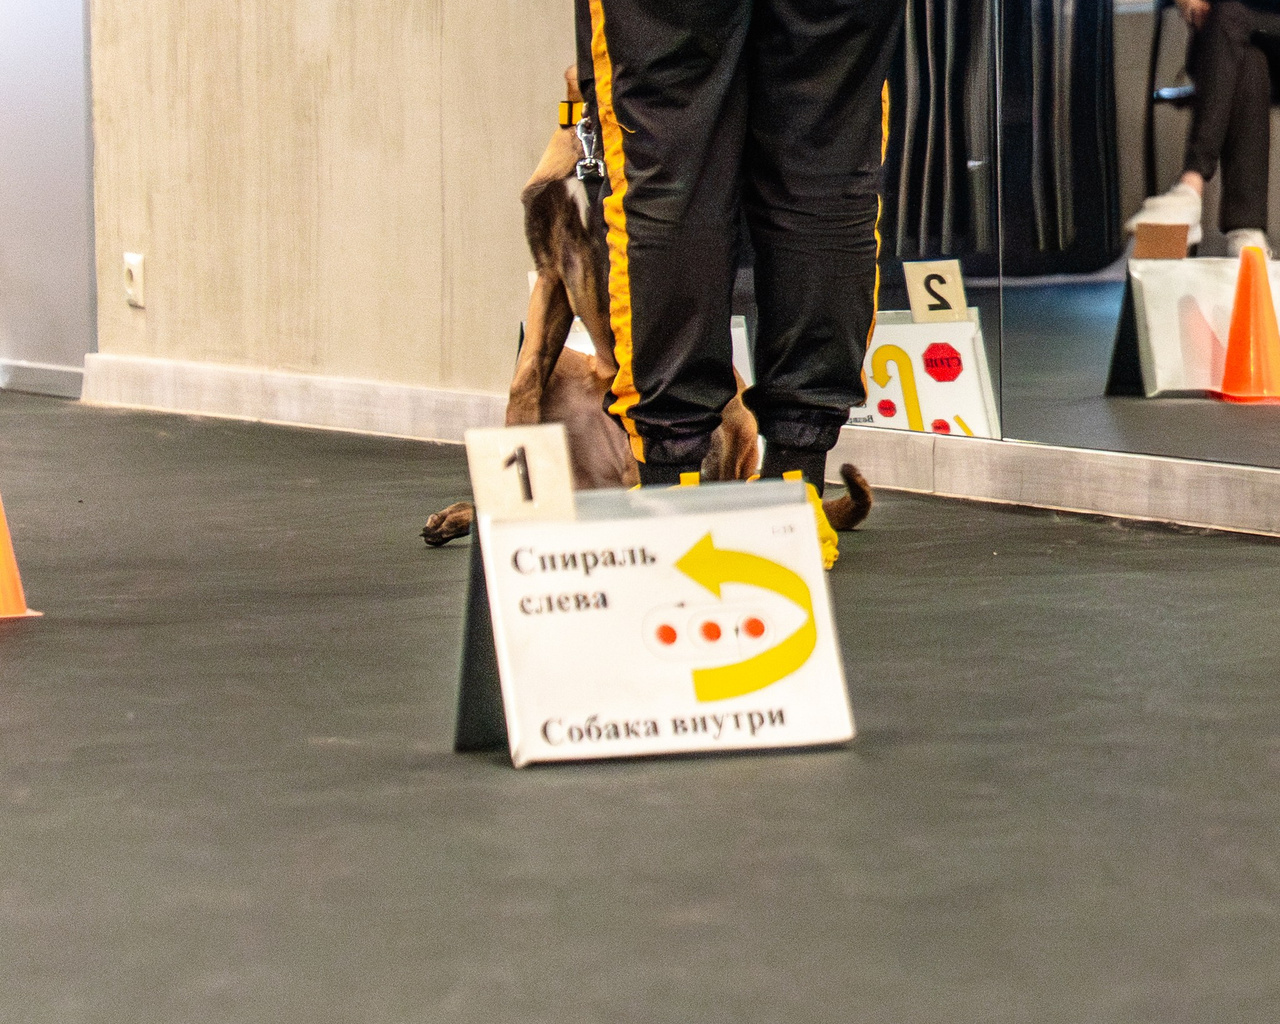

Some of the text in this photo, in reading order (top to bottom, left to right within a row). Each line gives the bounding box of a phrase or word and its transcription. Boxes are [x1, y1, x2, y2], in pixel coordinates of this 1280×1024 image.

[502, 444, 534, 503] 1
[511, 545, 657, 577] Спираль
[519, 589, 609, 616] слева
[541, 706, 787, 745] Собака внутри
